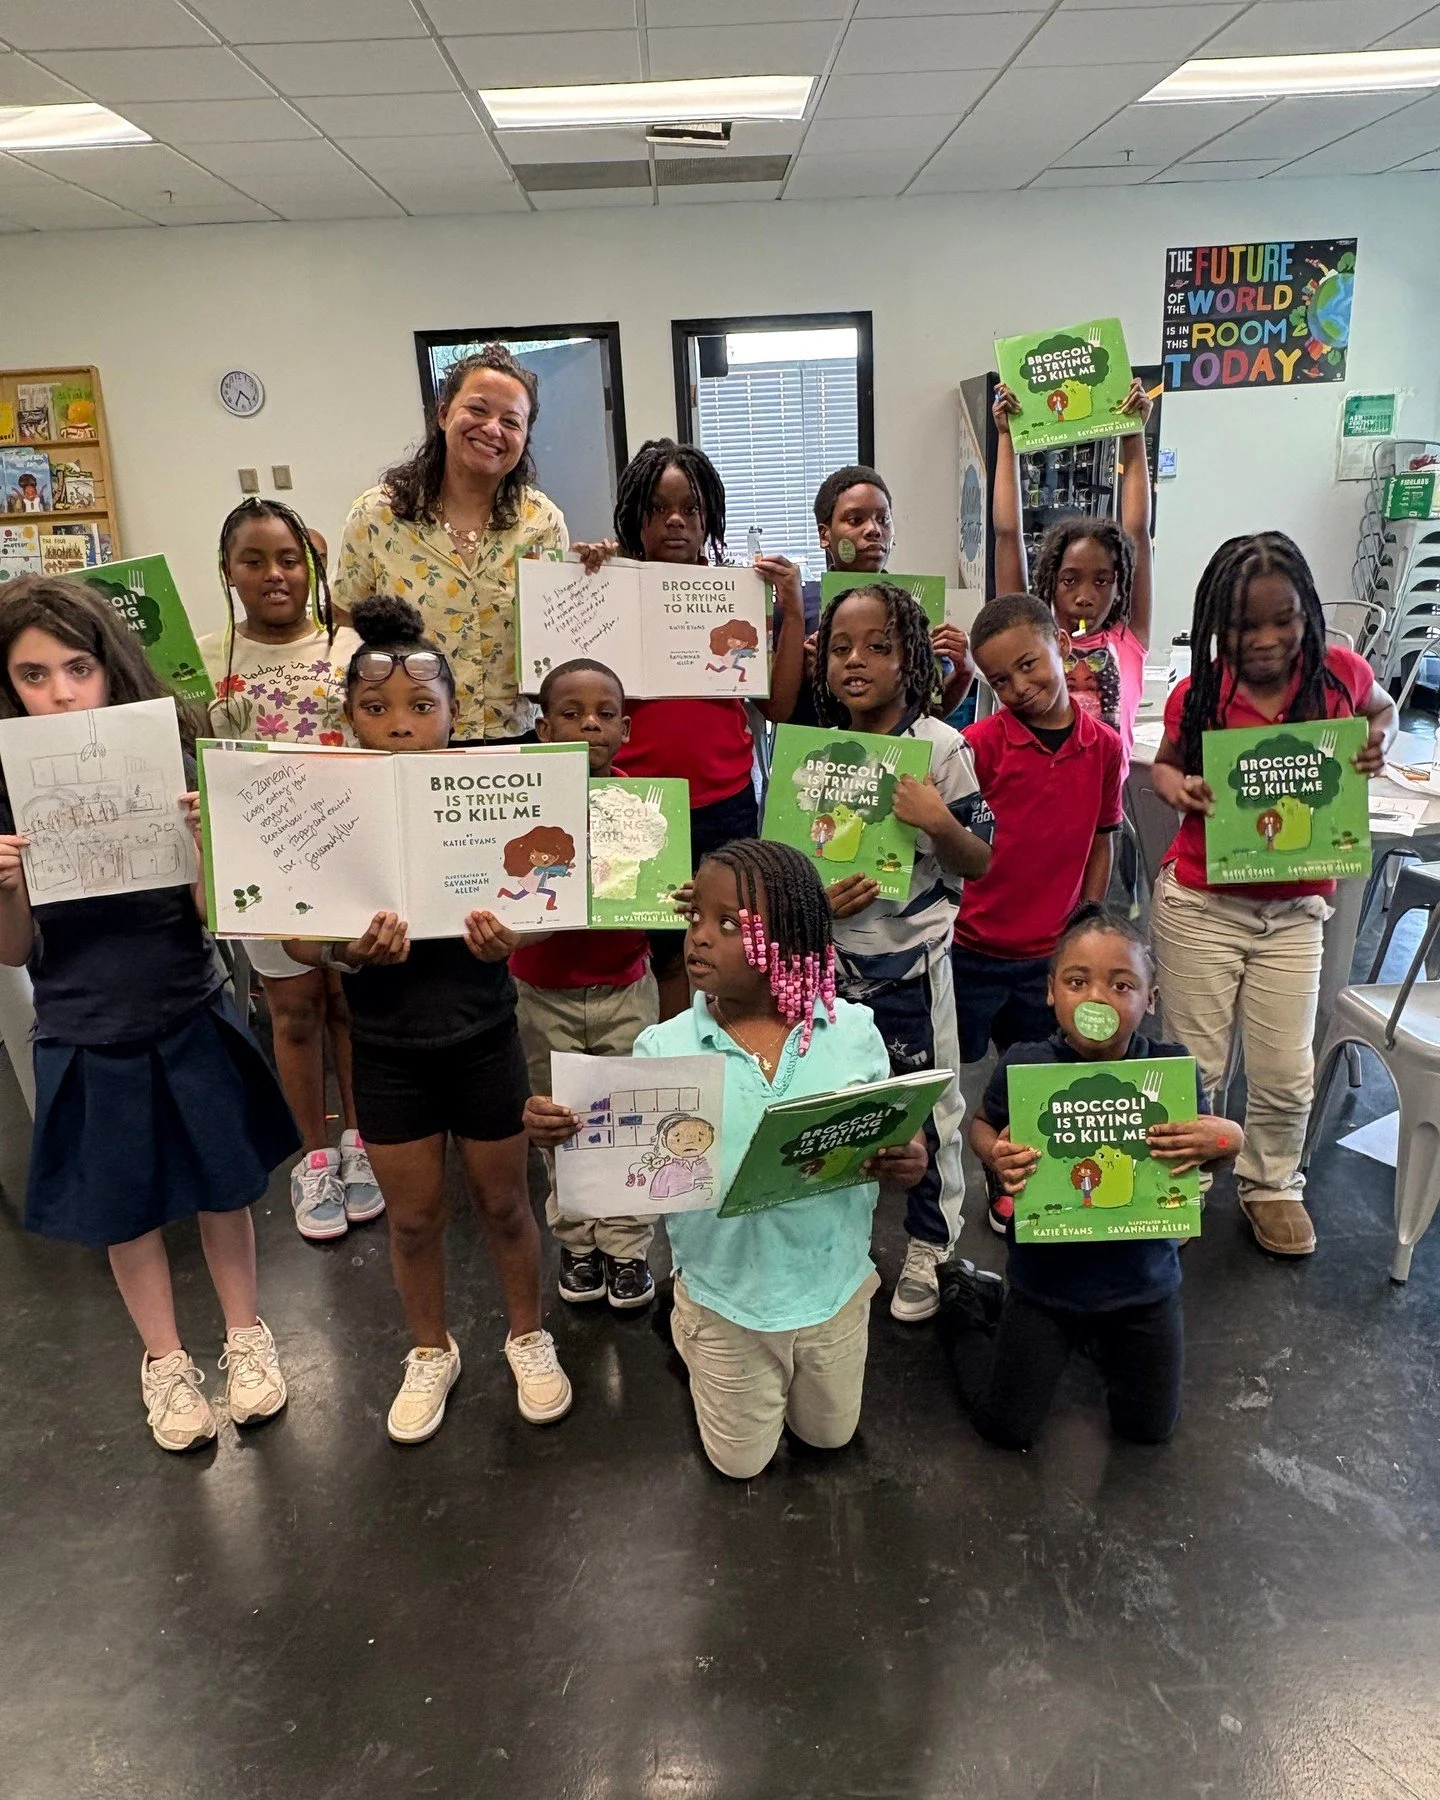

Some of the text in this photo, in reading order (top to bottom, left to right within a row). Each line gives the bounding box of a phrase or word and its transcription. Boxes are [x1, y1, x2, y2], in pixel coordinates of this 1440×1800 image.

[1168, 243, 1295, 287] THE FUTURE
[1167, 293, 1185, 304] OF
[1187, 284, 1293, 316] WORLD
[1166, 305, 1186, 315] THE
[1166, 325, 1190, 336] IS IN
[1191, 318, 1287, 349] ROOM
[1166, 339, 1189, 350] THIS
[1027, 344, 1093, 366] BROCCOLI
[1032, 355, 1092, 374] IS TRYING
[1164, 347, 1302, 388] TODAY
[1031, 365, 1096, 384] TO KILL ME
[662, 580, 735, 592] BROCCOLI
[672, 593, 727, 602] IS TRYING
[664, 603, 735, 614] TO KILL ME
[127, 619, 147, 631] ME
[241, 661, 309, 680] today is
[284, 673, 320, 686] good
[806, 759, 883, 780] BROCCOLI
[1240, 753, 1322, 771] BROCCOLI
[430, 773, 542, 791] BROCCOLI
[808, 775, 878, 792] IS TRYING
[1244, 767, 1319, 784] IS TRYING
[237, 789, 253, 804] To
[803, 787, 879, 806] TO KILL ME
[1241, 781, 1322, 796] TO KILL ME
[446, 792, 529, 807] IS TRYING
[434, 805, 541, 823] TO KILL ME
[443, 837, 497, 847] KATIE EVANS
[444, 877, 490, 888] SAVANNAH
[455, 886, 480, 894] ALLEN
[880, 884, 899, 894] LLEN
[1052, 1097, 1146, 1115] BROCCOLI
[801, 1109, 893, 1140] BROCCOLI
[1057, 1112, 1143, 1129] IS TRYING
[793, 1127, 880, 1157] TO KILL ME
[801, 1119, 883, 1148] IS TRYING
[1053, 1128, 1146, 1144] TO KILL ME
[1033, 1225, 1093, 1237] KATIE EVANS
[1107, 1221, 1190, 1235] SAVANNAH ALLEN
